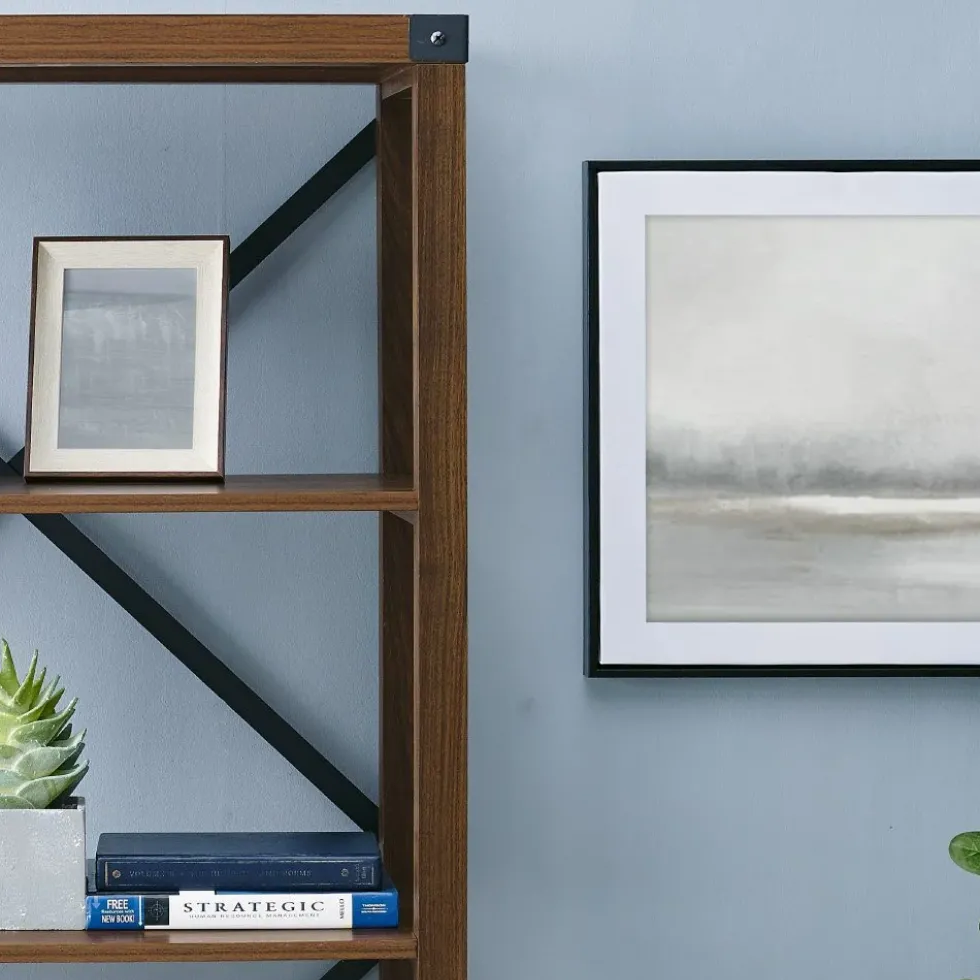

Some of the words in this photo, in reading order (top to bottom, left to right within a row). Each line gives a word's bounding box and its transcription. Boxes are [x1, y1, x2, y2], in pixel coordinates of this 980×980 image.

[107, 899, 128, 909] FREE
[183, 901, 325, 913] STRATEGIC
[101, 914, 115, 923] NEW
